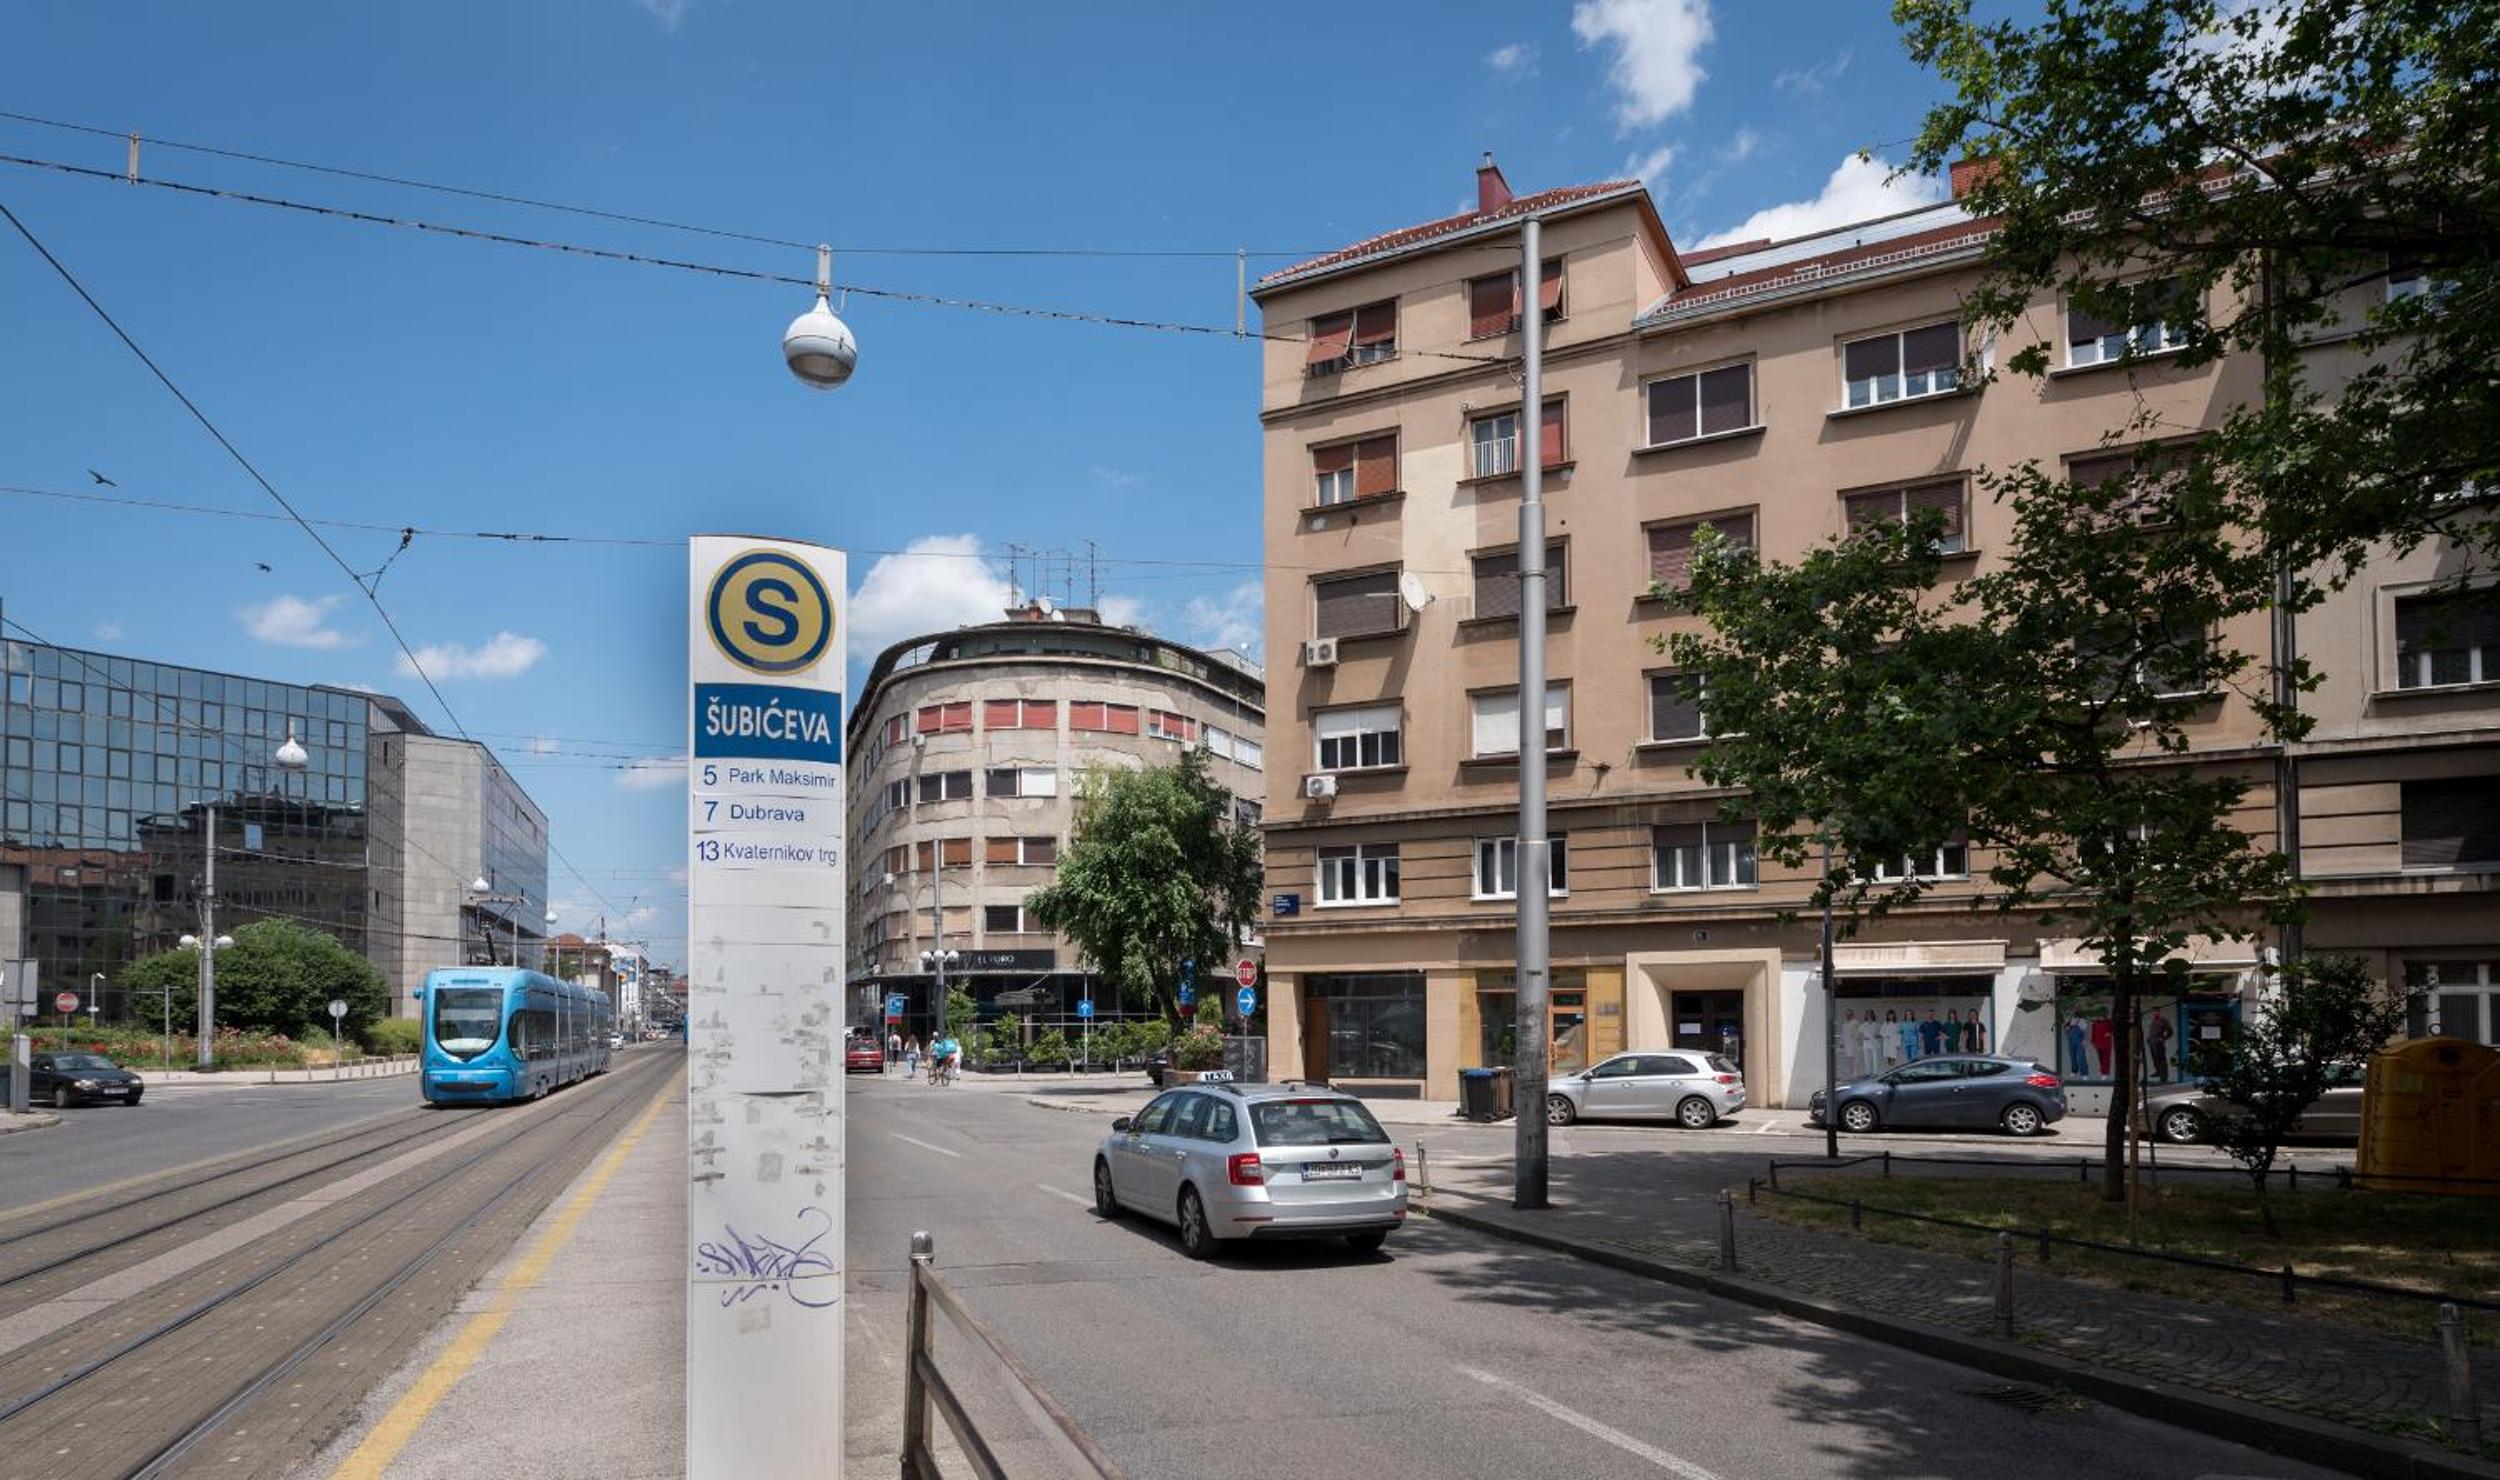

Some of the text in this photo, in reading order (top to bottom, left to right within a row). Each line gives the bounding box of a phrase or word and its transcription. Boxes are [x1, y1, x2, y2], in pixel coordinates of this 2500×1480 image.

[743, 577, 799, 647] S
[706, 696, 832, 745] ŠUBIĆEVA
[703, 764, 837, 788] 5 Park Maksimir
[704, 801, 805, 822] 7 Dubrava
[696, 840, 838, 867] 13 Kvaternikov trg
